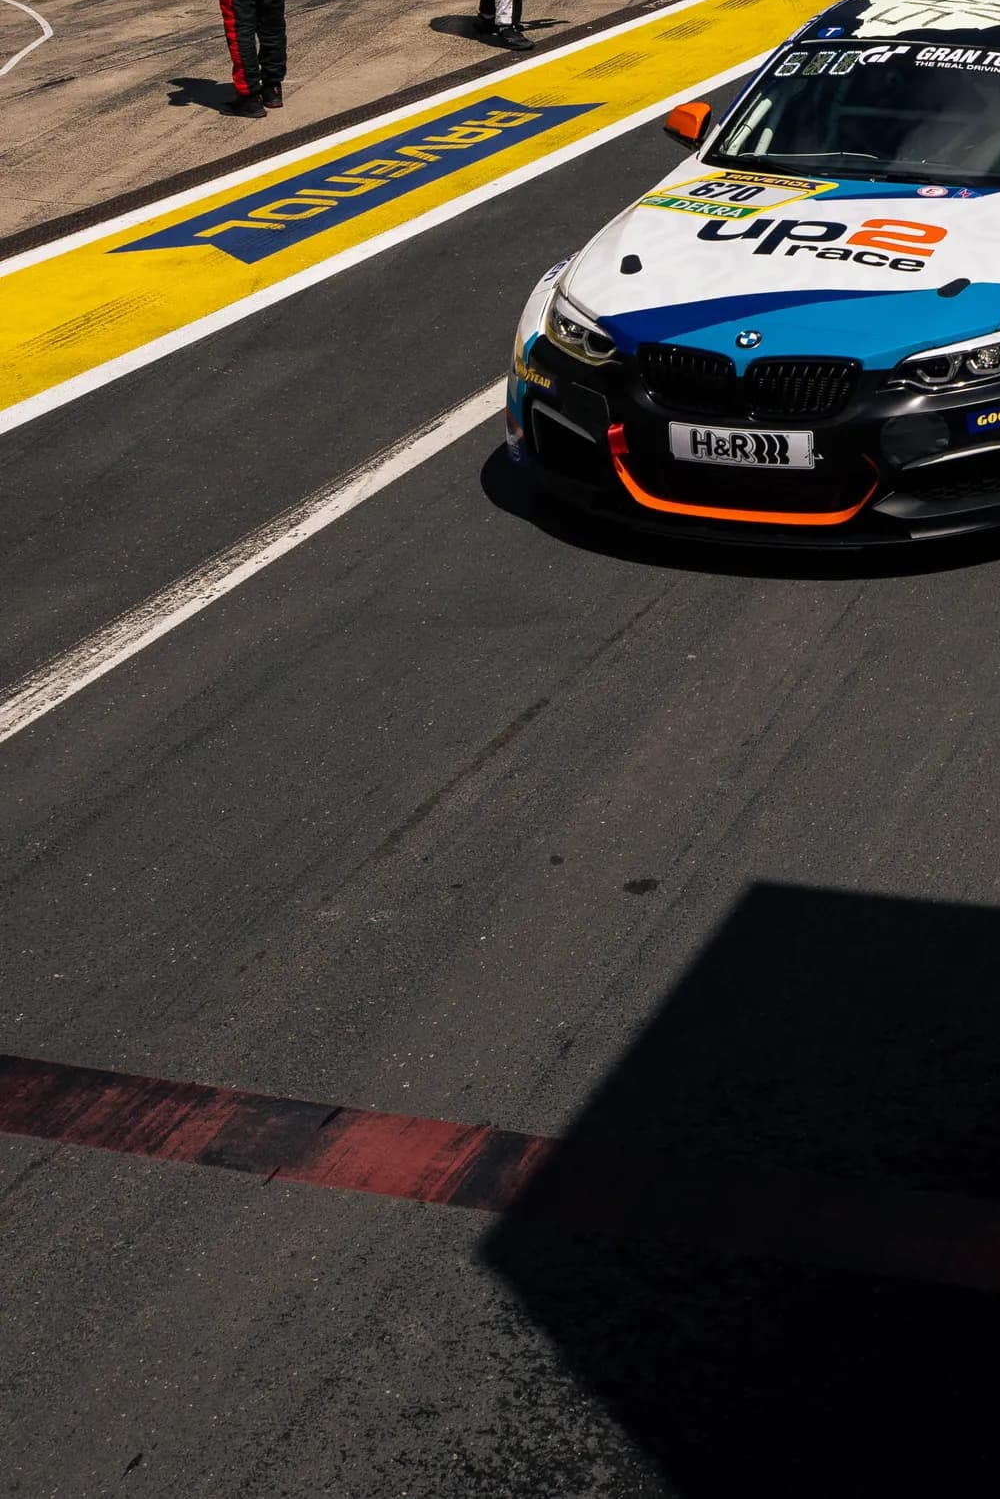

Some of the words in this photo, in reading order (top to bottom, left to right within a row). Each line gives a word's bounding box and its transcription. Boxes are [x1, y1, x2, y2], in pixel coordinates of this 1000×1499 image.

[914, 60, 932, 68] THE
[934, 61, 962, 71] REAL
[916, 47, 976, 64] GRAN
[194, 109, 544, 239] RAVENOL
[727, 172, 816, 189] RAVENOL
[688, 180, 766, 202] 670
[671, 200, 744, 218] DEKRA
[784, 244, 926, 272] race
[690, 429, 753, 460] H&R
